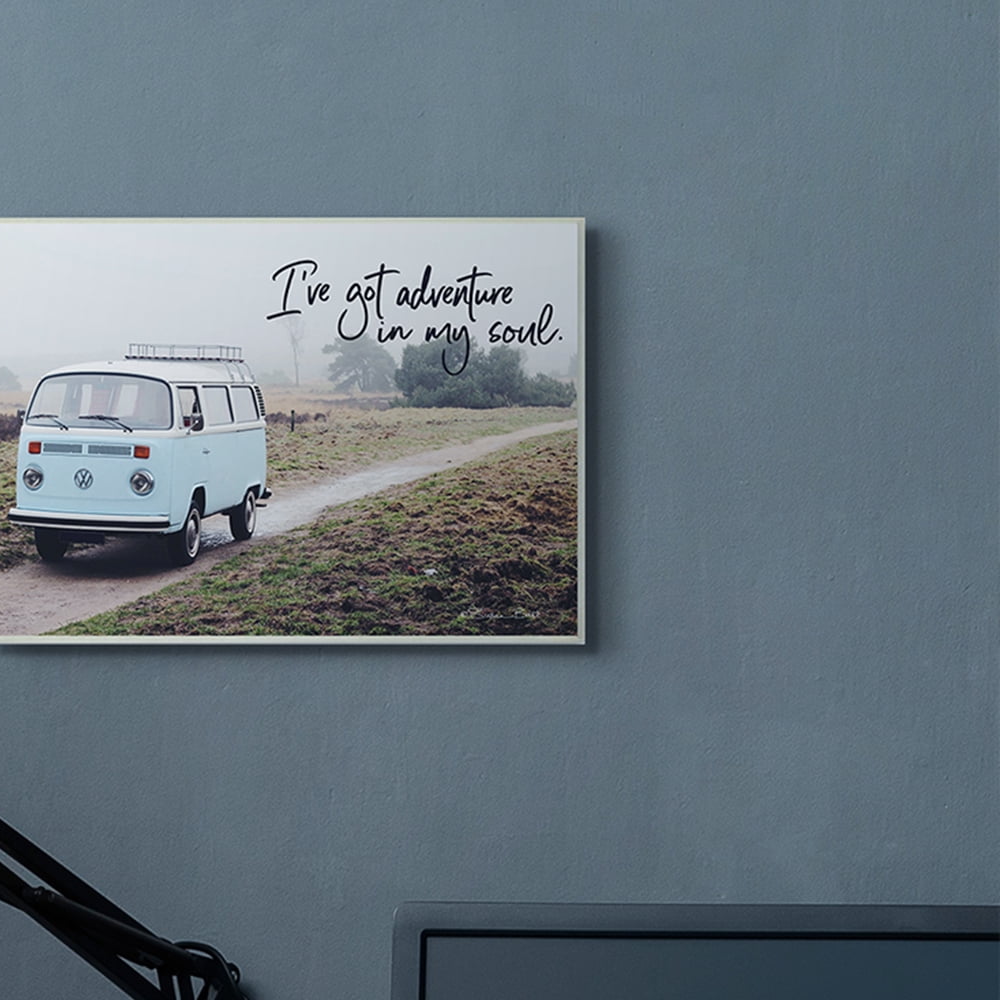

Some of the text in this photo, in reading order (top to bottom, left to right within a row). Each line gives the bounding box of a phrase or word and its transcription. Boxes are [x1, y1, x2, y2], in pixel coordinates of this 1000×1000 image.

[266, 259, 513, 340] I've got adventure
[377, 303, 563, 376] in my soul.
